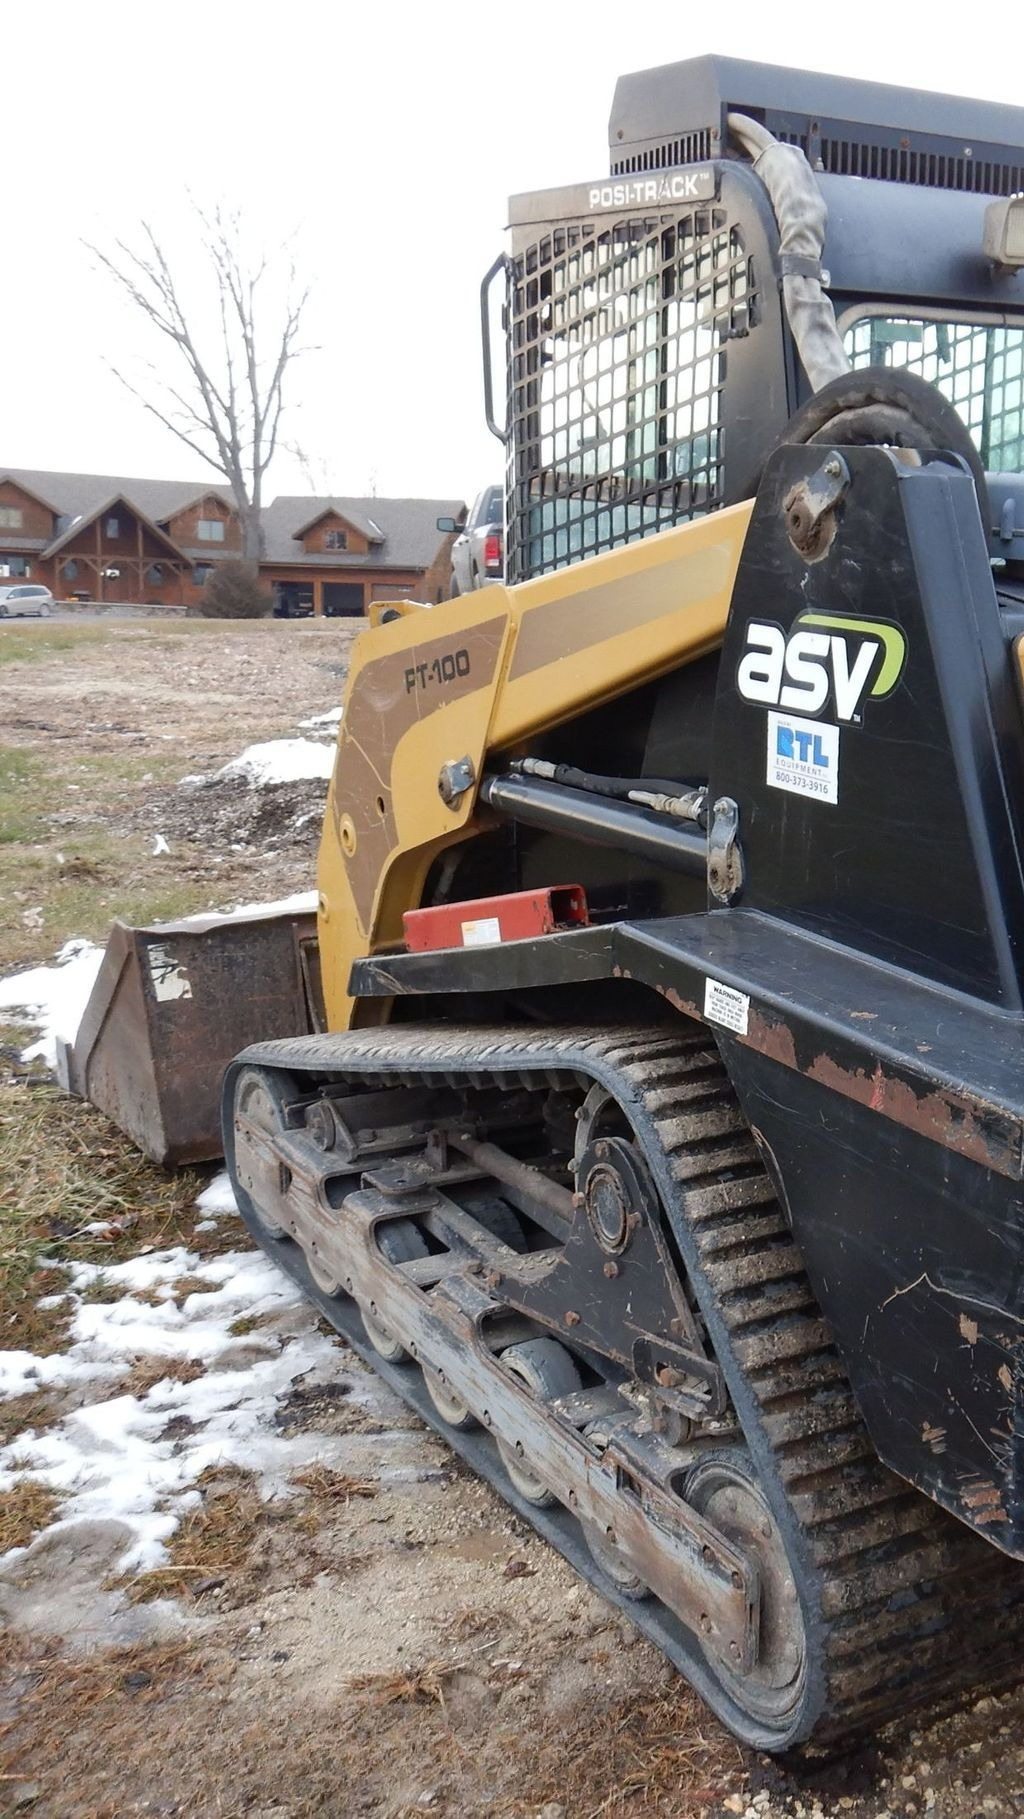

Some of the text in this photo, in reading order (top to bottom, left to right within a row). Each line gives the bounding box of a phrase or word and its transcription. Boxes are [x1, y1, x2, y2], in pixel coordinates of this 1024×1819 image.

[588, 173, 699, 209] POSI-TRACK
[777, 725, 829, 768] RTL
[776, 758, 822, 776] EQUIPMENT
[775, 771, 829, 794] 800-373-3916
[713, 986, 743, 1004] WARNING
